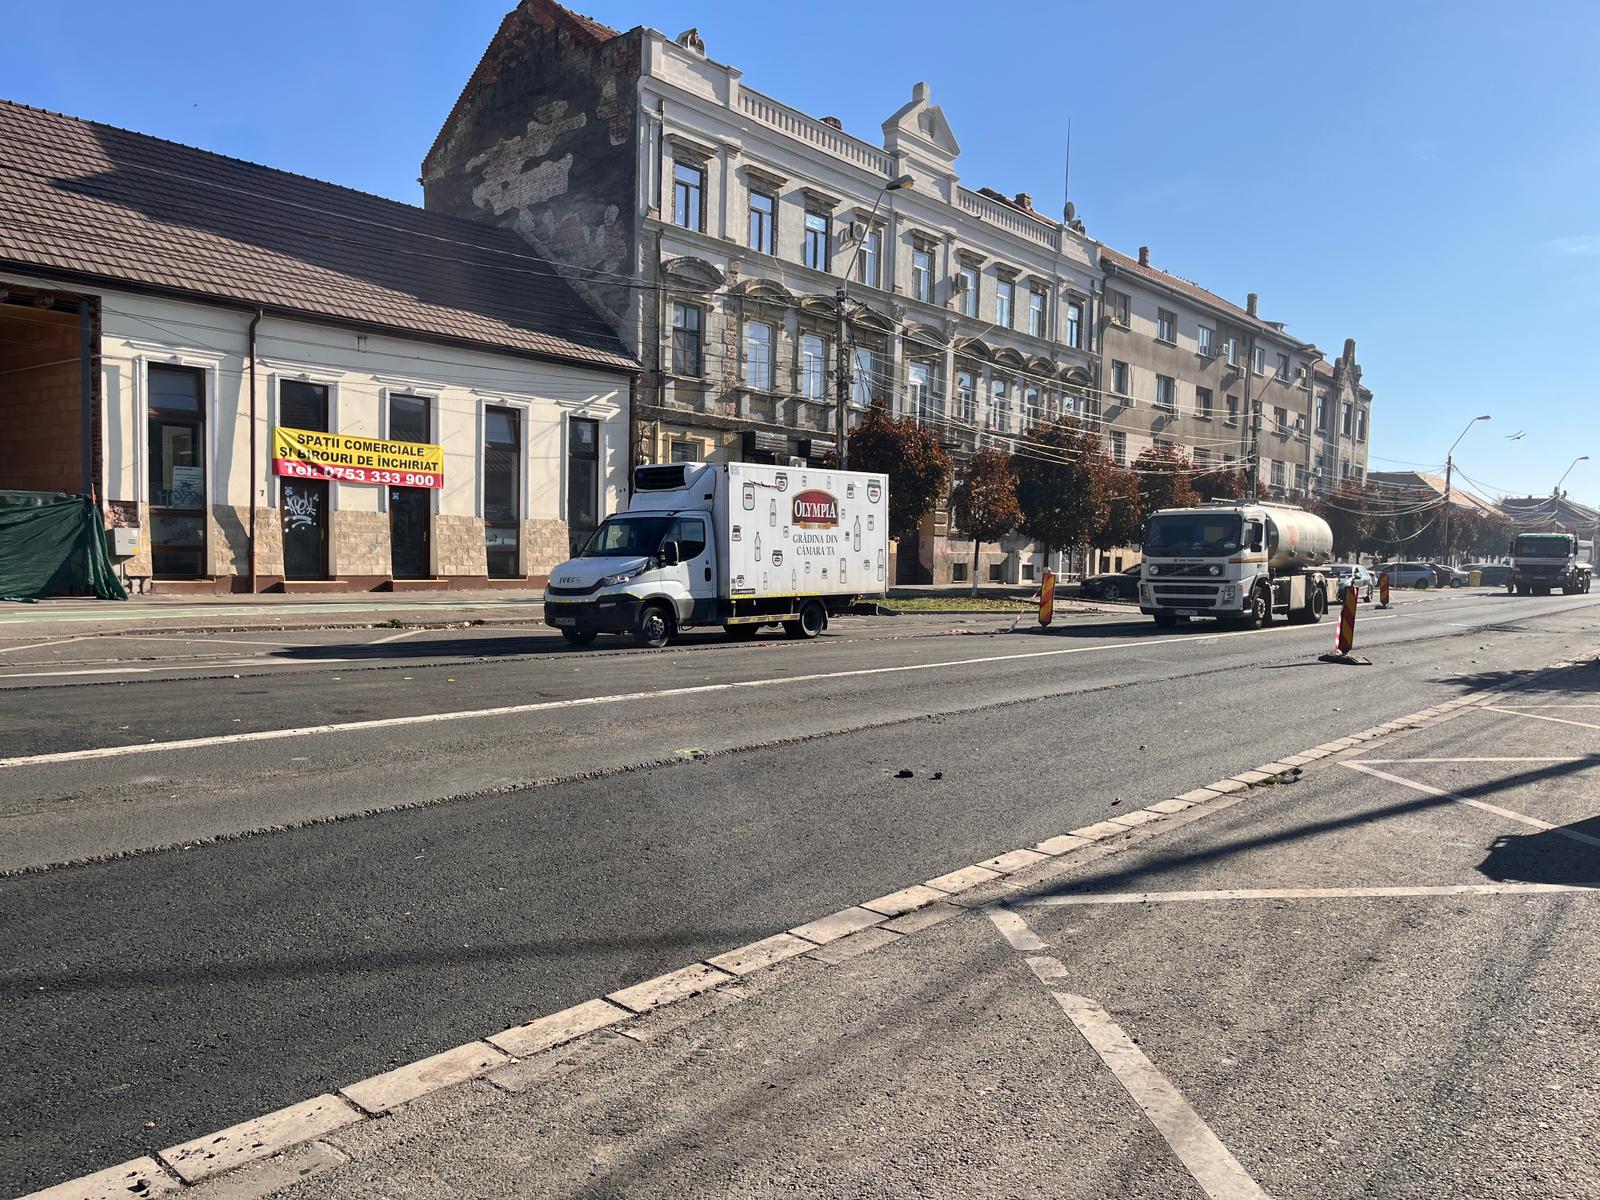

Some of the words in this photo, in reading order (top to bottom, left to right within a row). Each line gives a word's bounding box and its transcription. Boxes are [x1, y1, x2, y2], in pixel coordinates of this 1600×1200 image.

[297, 433, 339, 450] SPAȚII
[344, 439, 424, 457] COMERCIALE
[297, 448, 353, 464] BIROURI
[357, 455, 374, 466] DE
[377, 454, 438, 471] ÎNCHIRIAT
[323, 465, 365, 481] 0753
[371, 470, 400, 483] 333
[406, 473, 434, 486] 900
[794, 499, 837, 518] OLYMPIA
[826, 534, 838, 543] DIN
[827, 546, 835, 556] TA
